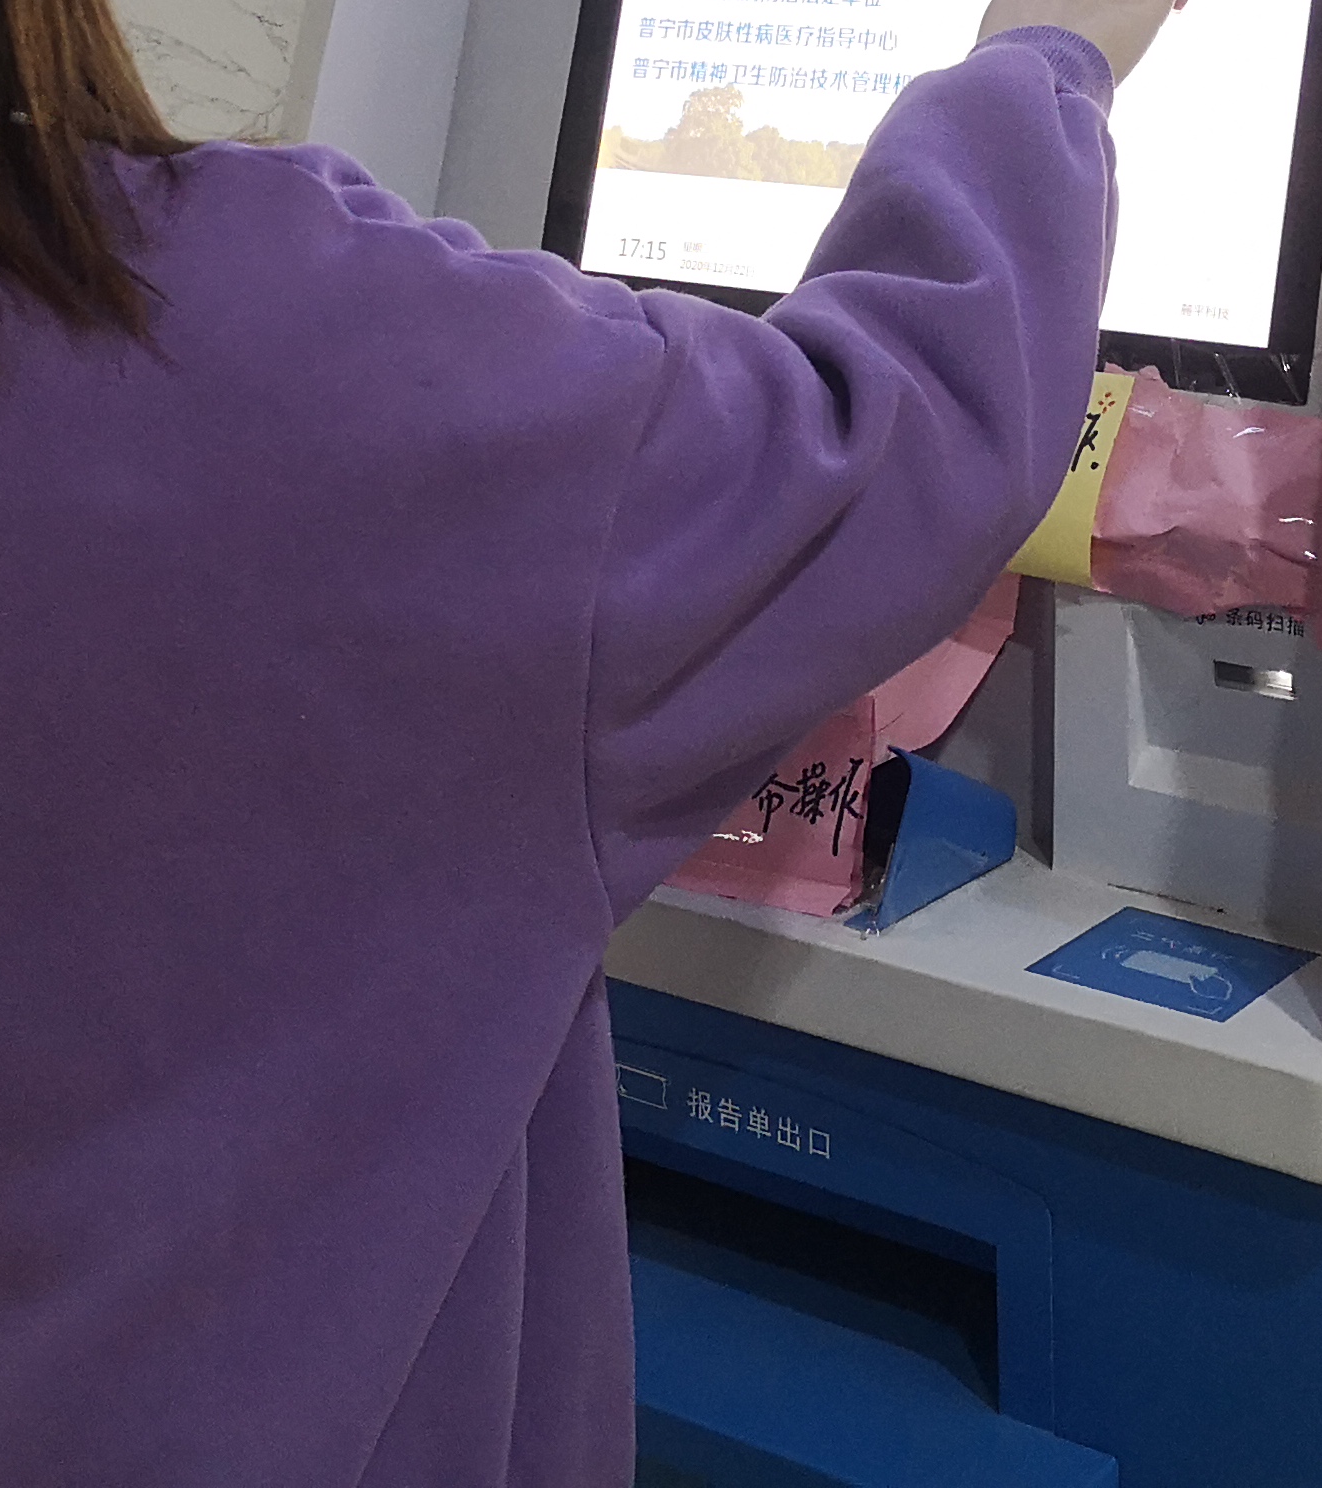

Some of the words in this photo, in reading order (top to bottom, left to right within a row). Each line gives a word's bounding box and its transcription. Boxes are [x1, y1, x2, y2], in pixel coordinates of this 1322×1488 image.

[639, 17, 898, 52] 普宁市皮肤性病医疗指导中心
[618, 238, 667, 261] 17:15
[1226, 608, 1304, 638] 条码扫描
[686, 1087, 830, 1159] 报告单出口
